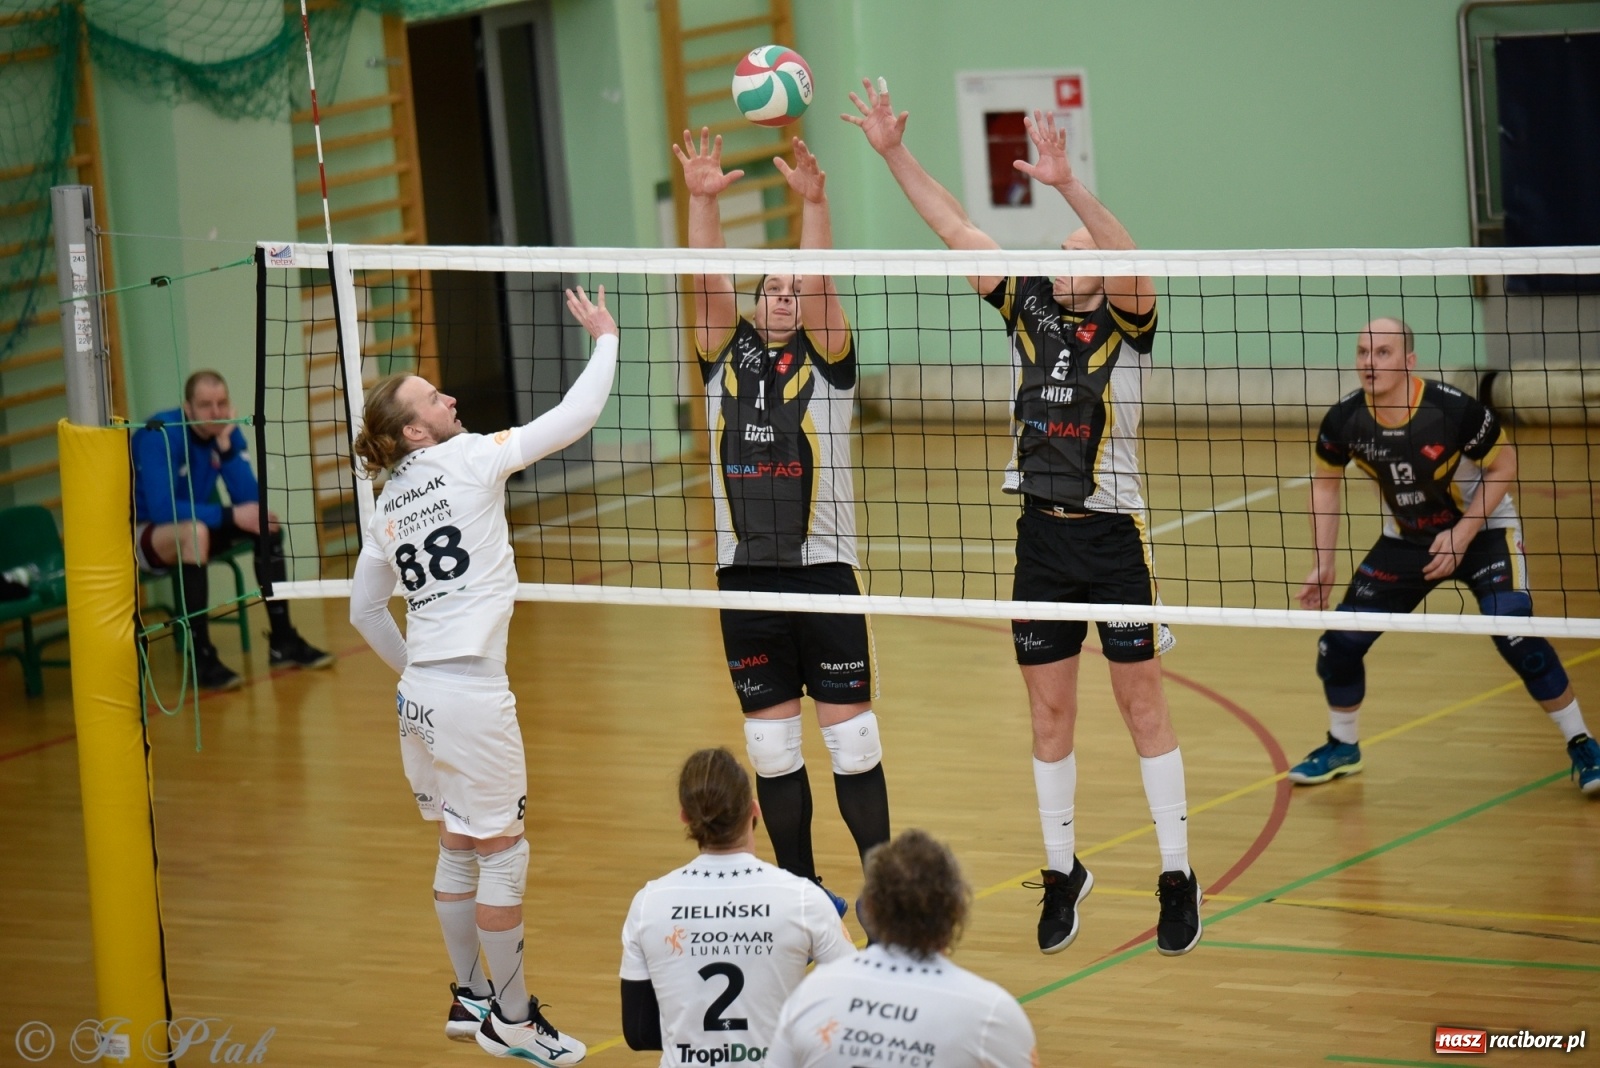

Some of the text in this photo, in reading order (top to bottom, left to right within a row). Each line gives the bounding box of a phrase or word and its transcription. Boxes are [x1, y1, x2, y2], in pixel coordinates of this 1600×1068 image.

[796, 69, 811, 98] RLPS
[1051, 348, 1071, 381] 2
[1041, 385, 1073, 405] ENTER
[1389, 462, 1416, 485] 13
[1395, 491, 1426, 507] ENTER
[397, 509, 453, 540] LUNATYCY
[395, 525, 470, 592] 88
[406, 699, 435, 729] DK
[671, 901, 771, 920] ZIELIŃSKI
[690, 945, 774, 957] LUNATYCY
[697, 961, 749, 1032] 2
[848, 997, 919, 1023] PYCIU
[838, 1043, 934, 1068] LUNATYCY
